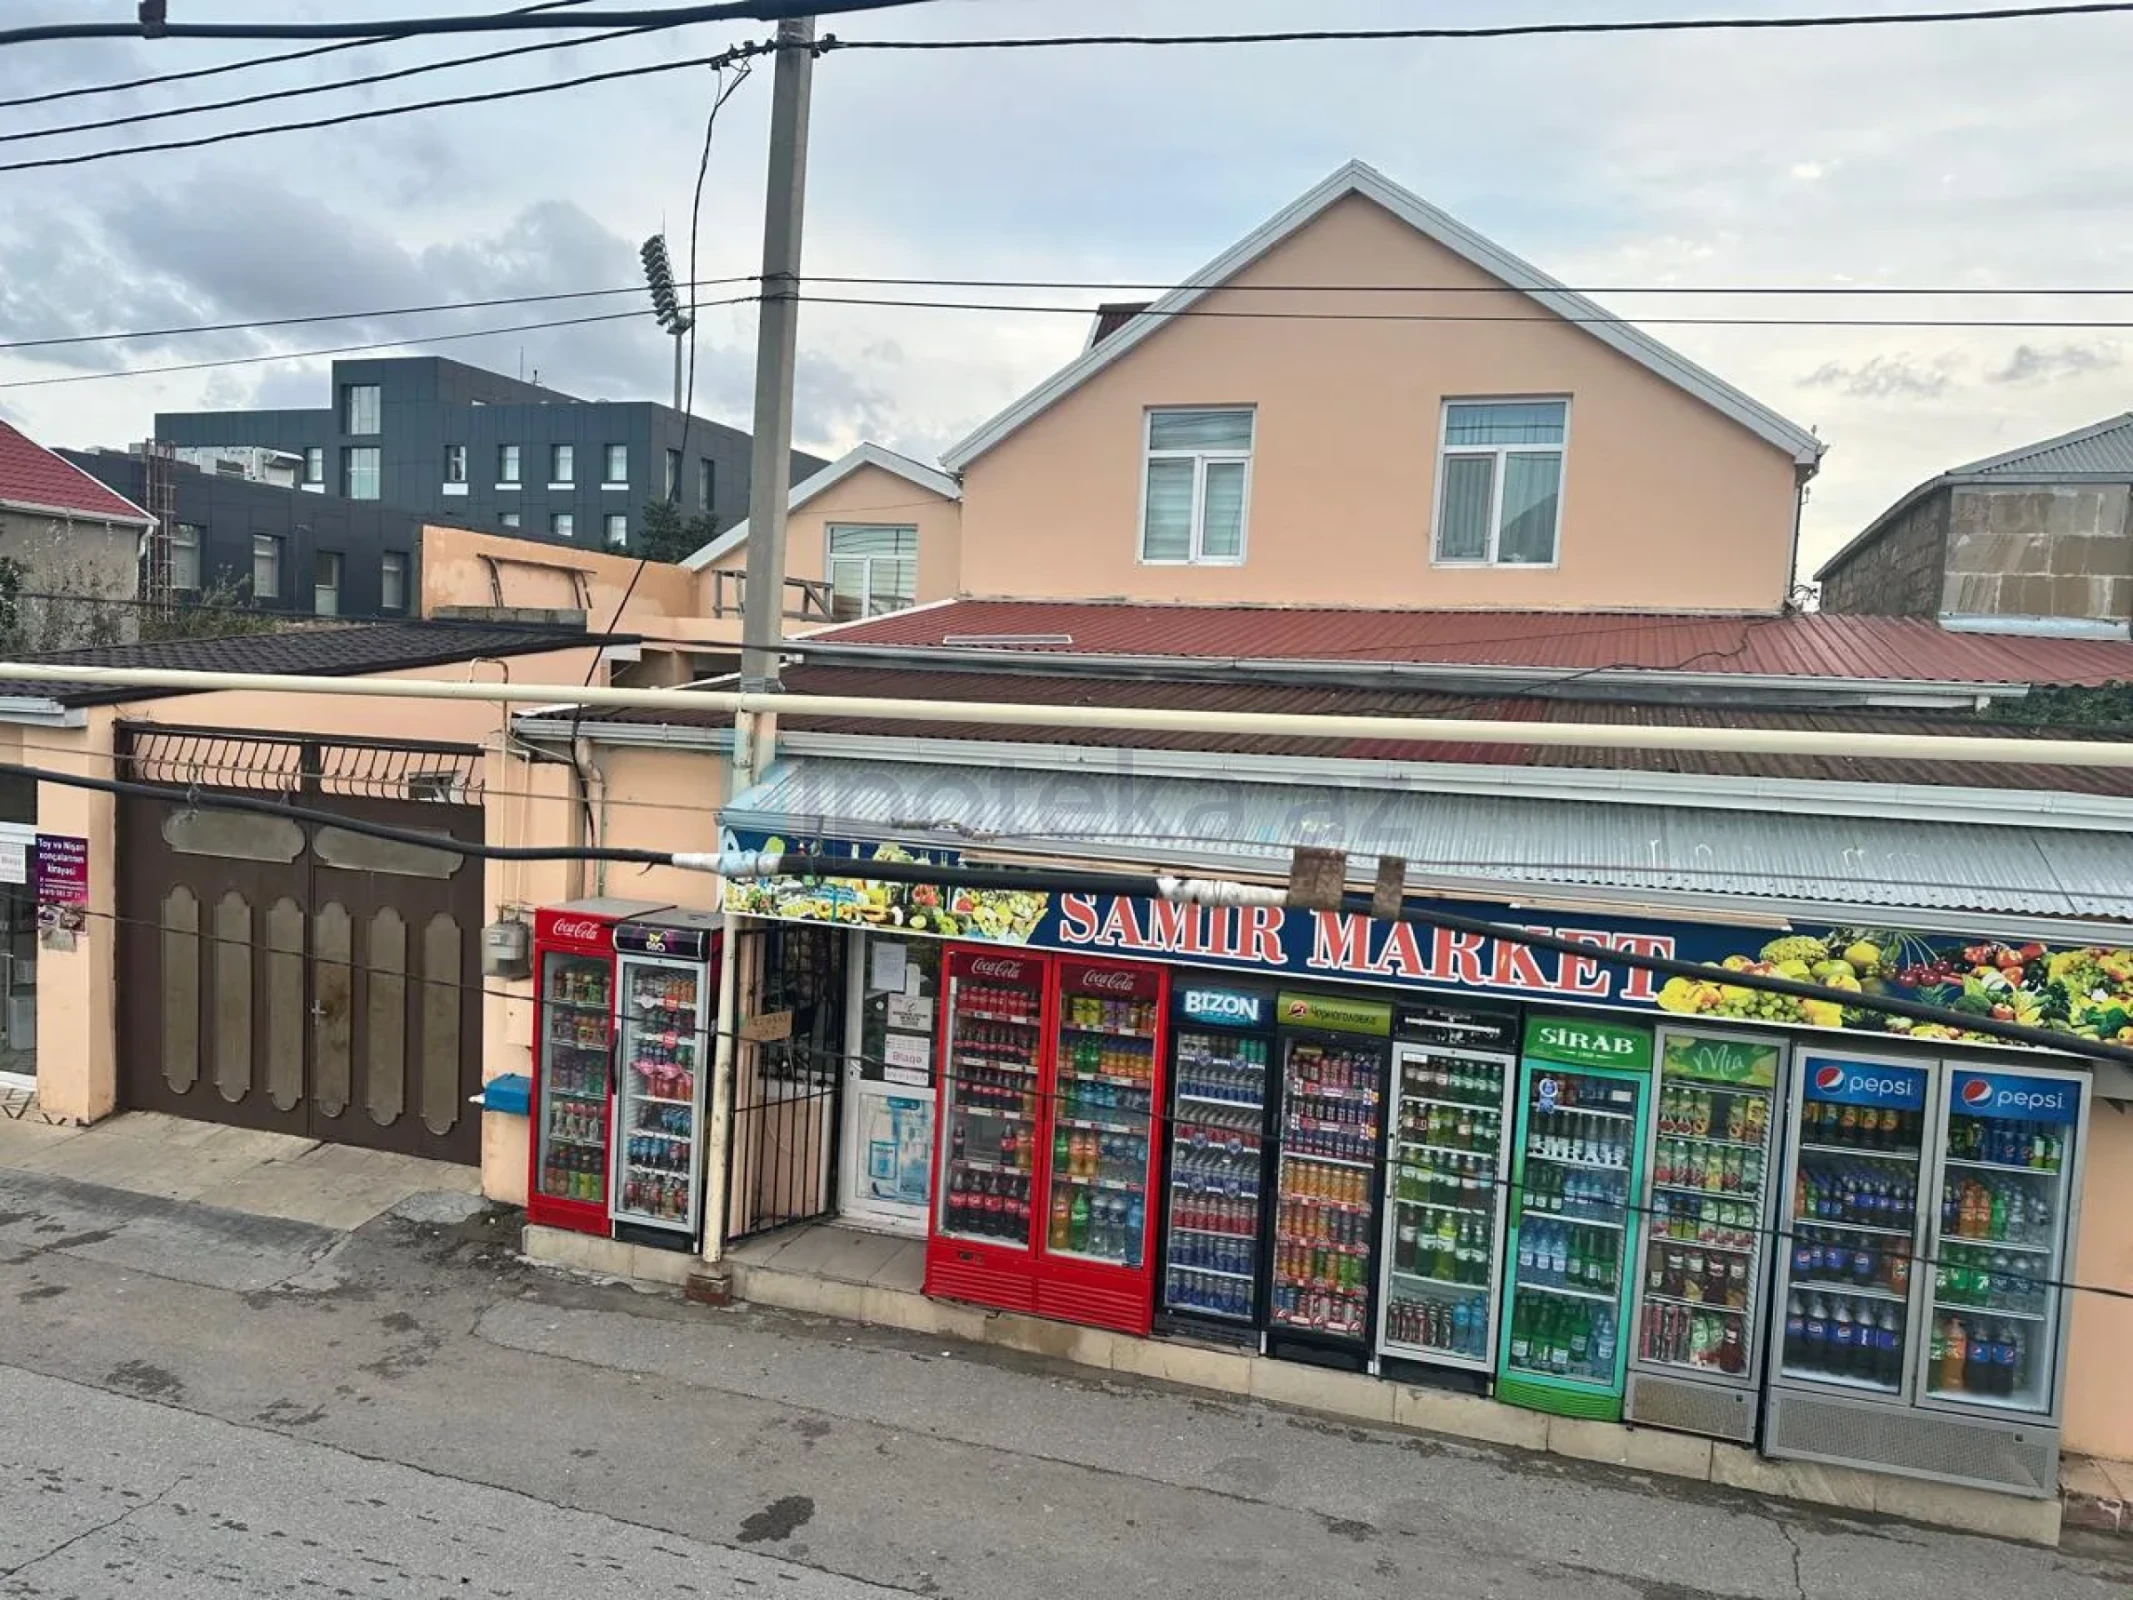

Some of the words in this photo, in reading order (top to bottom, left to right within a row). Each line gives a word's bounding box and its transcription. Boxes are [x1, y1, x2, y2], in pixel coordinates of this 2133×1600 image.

[1059, 892, 1289, 965] SAMIR
[1305, 908, 1676, 1001] MARKET
[1184, 990, 1259, 1021] BIZON
[1693, 1044, 1746, 1080] Mia
[1850, 1075, 1912, 1097] pepsi
[1997, 1090, 2064, 1109] pepsi
